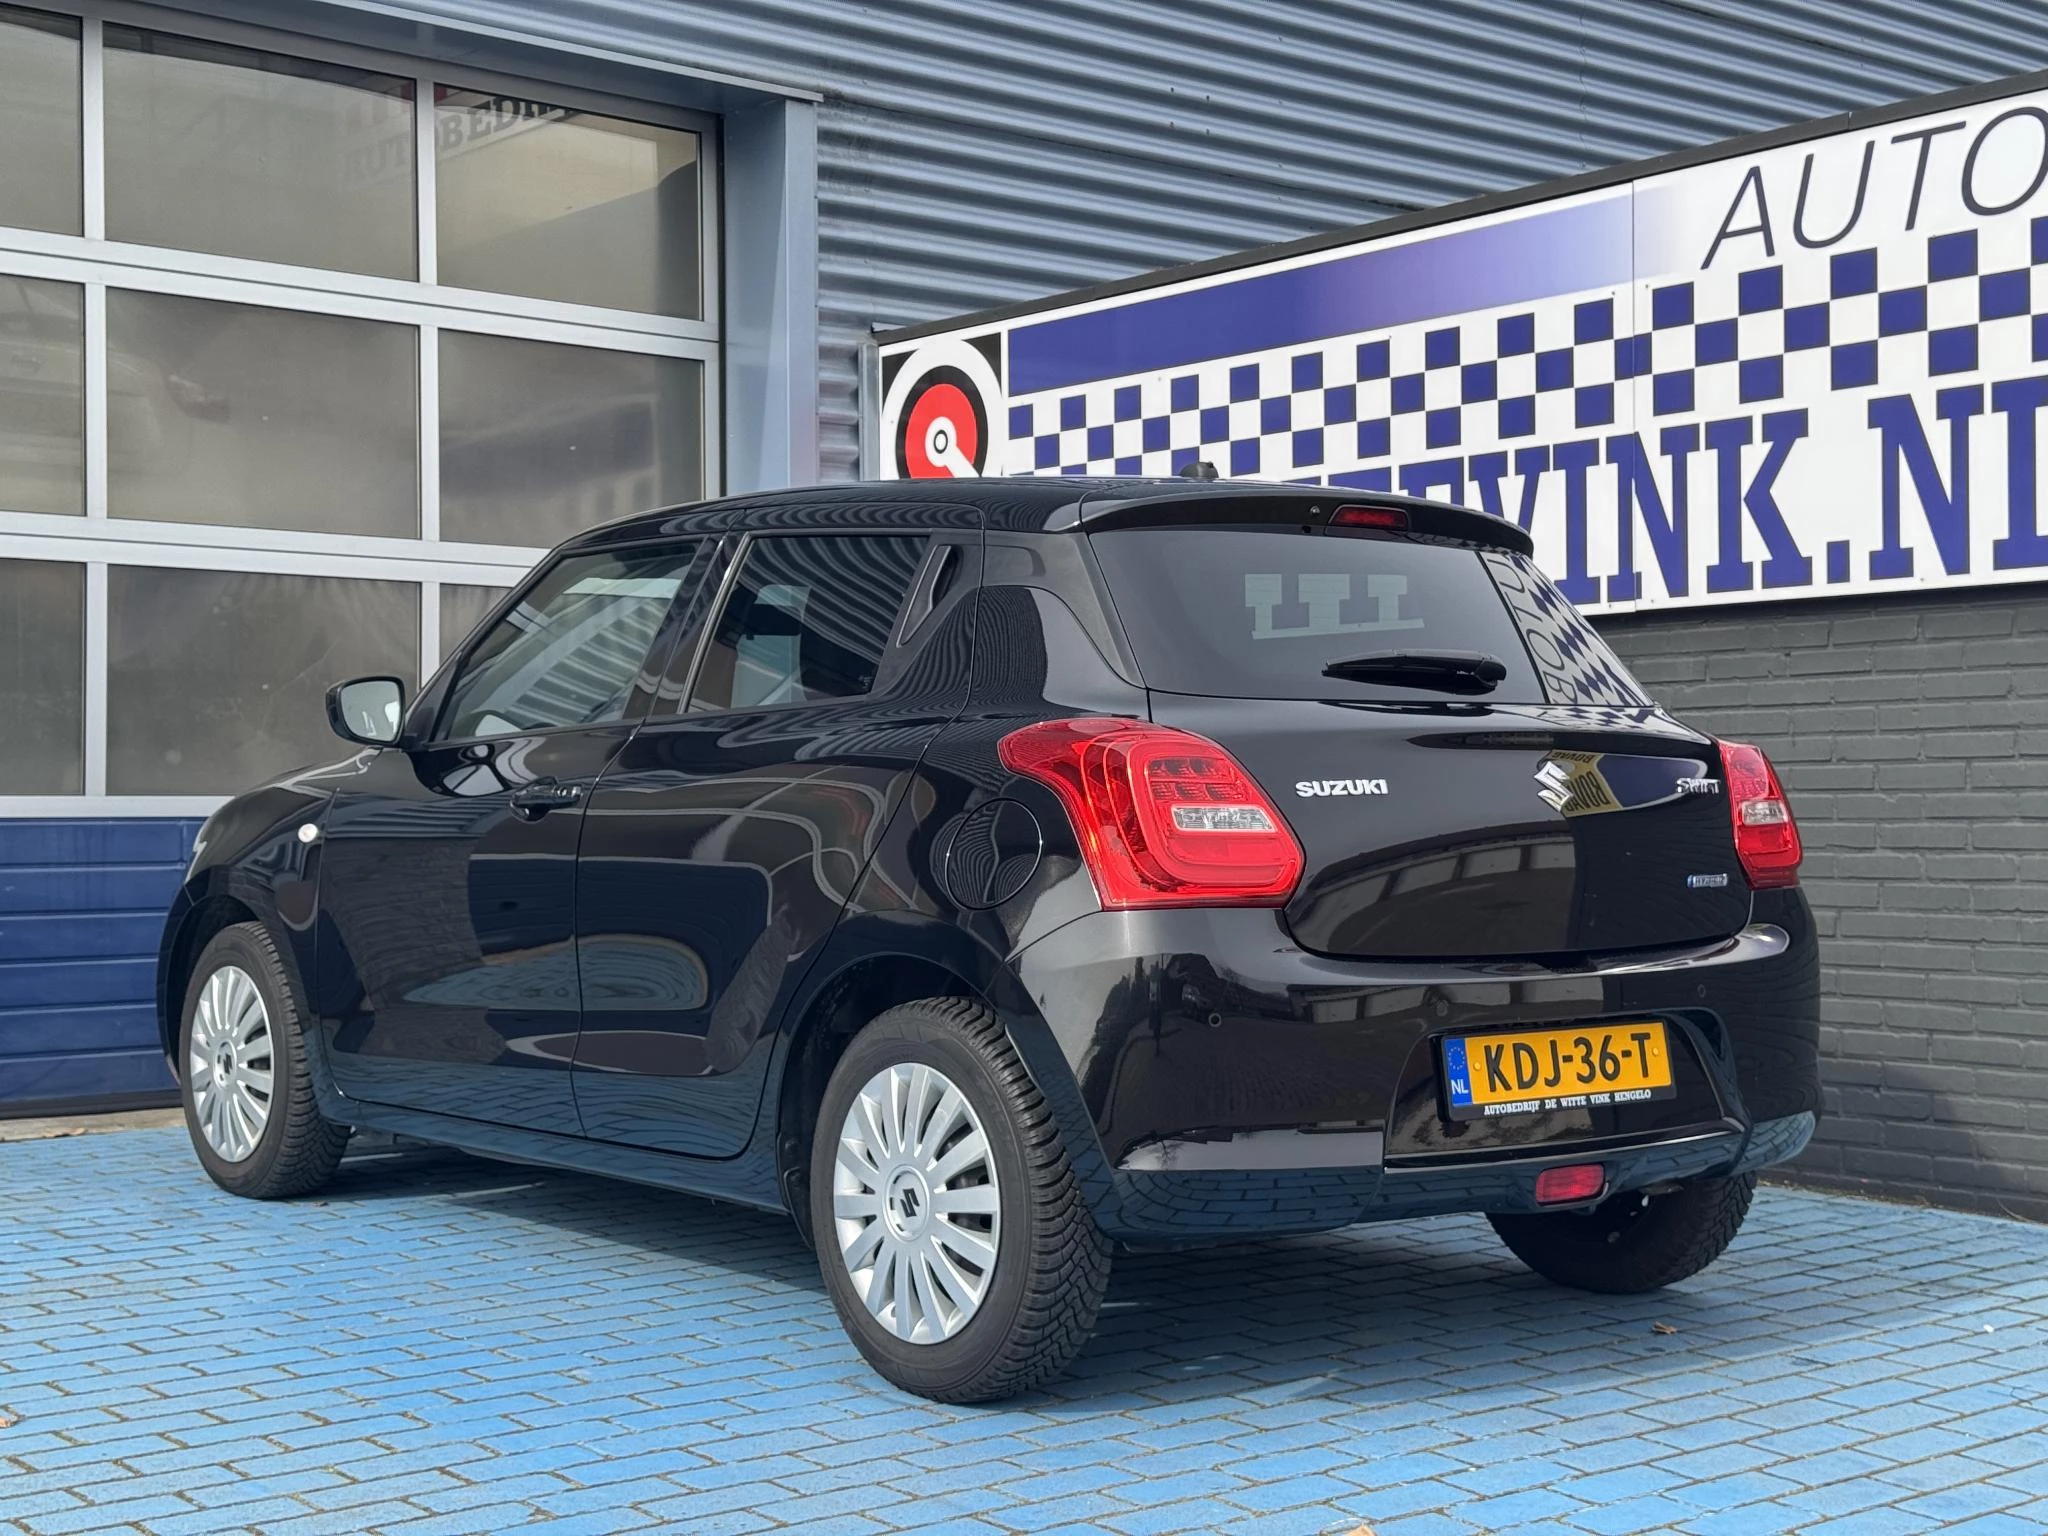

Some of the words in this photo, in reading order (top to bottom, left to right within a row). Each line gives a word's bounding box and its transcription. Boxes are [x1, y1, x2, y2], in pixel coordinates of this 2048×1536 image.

[1700, 106, 2048, 270] AUTO
[1295, 779, 1388, 797] SUZUKI
[1483, 1032, 1651, 1093] KDJ-36-T
[1451, 1078, 1469, 1095] NL
[1484, 1101, 1540, 1116] AUTOBEDRIJF
[1545, 1098, 1557, 1109] DE
[1561, 1096, 1586, 1107] WITTE
[1590, 1093, 1610, 1105] VINK
[1614, 1089, 1651, 1101] HENGELO
